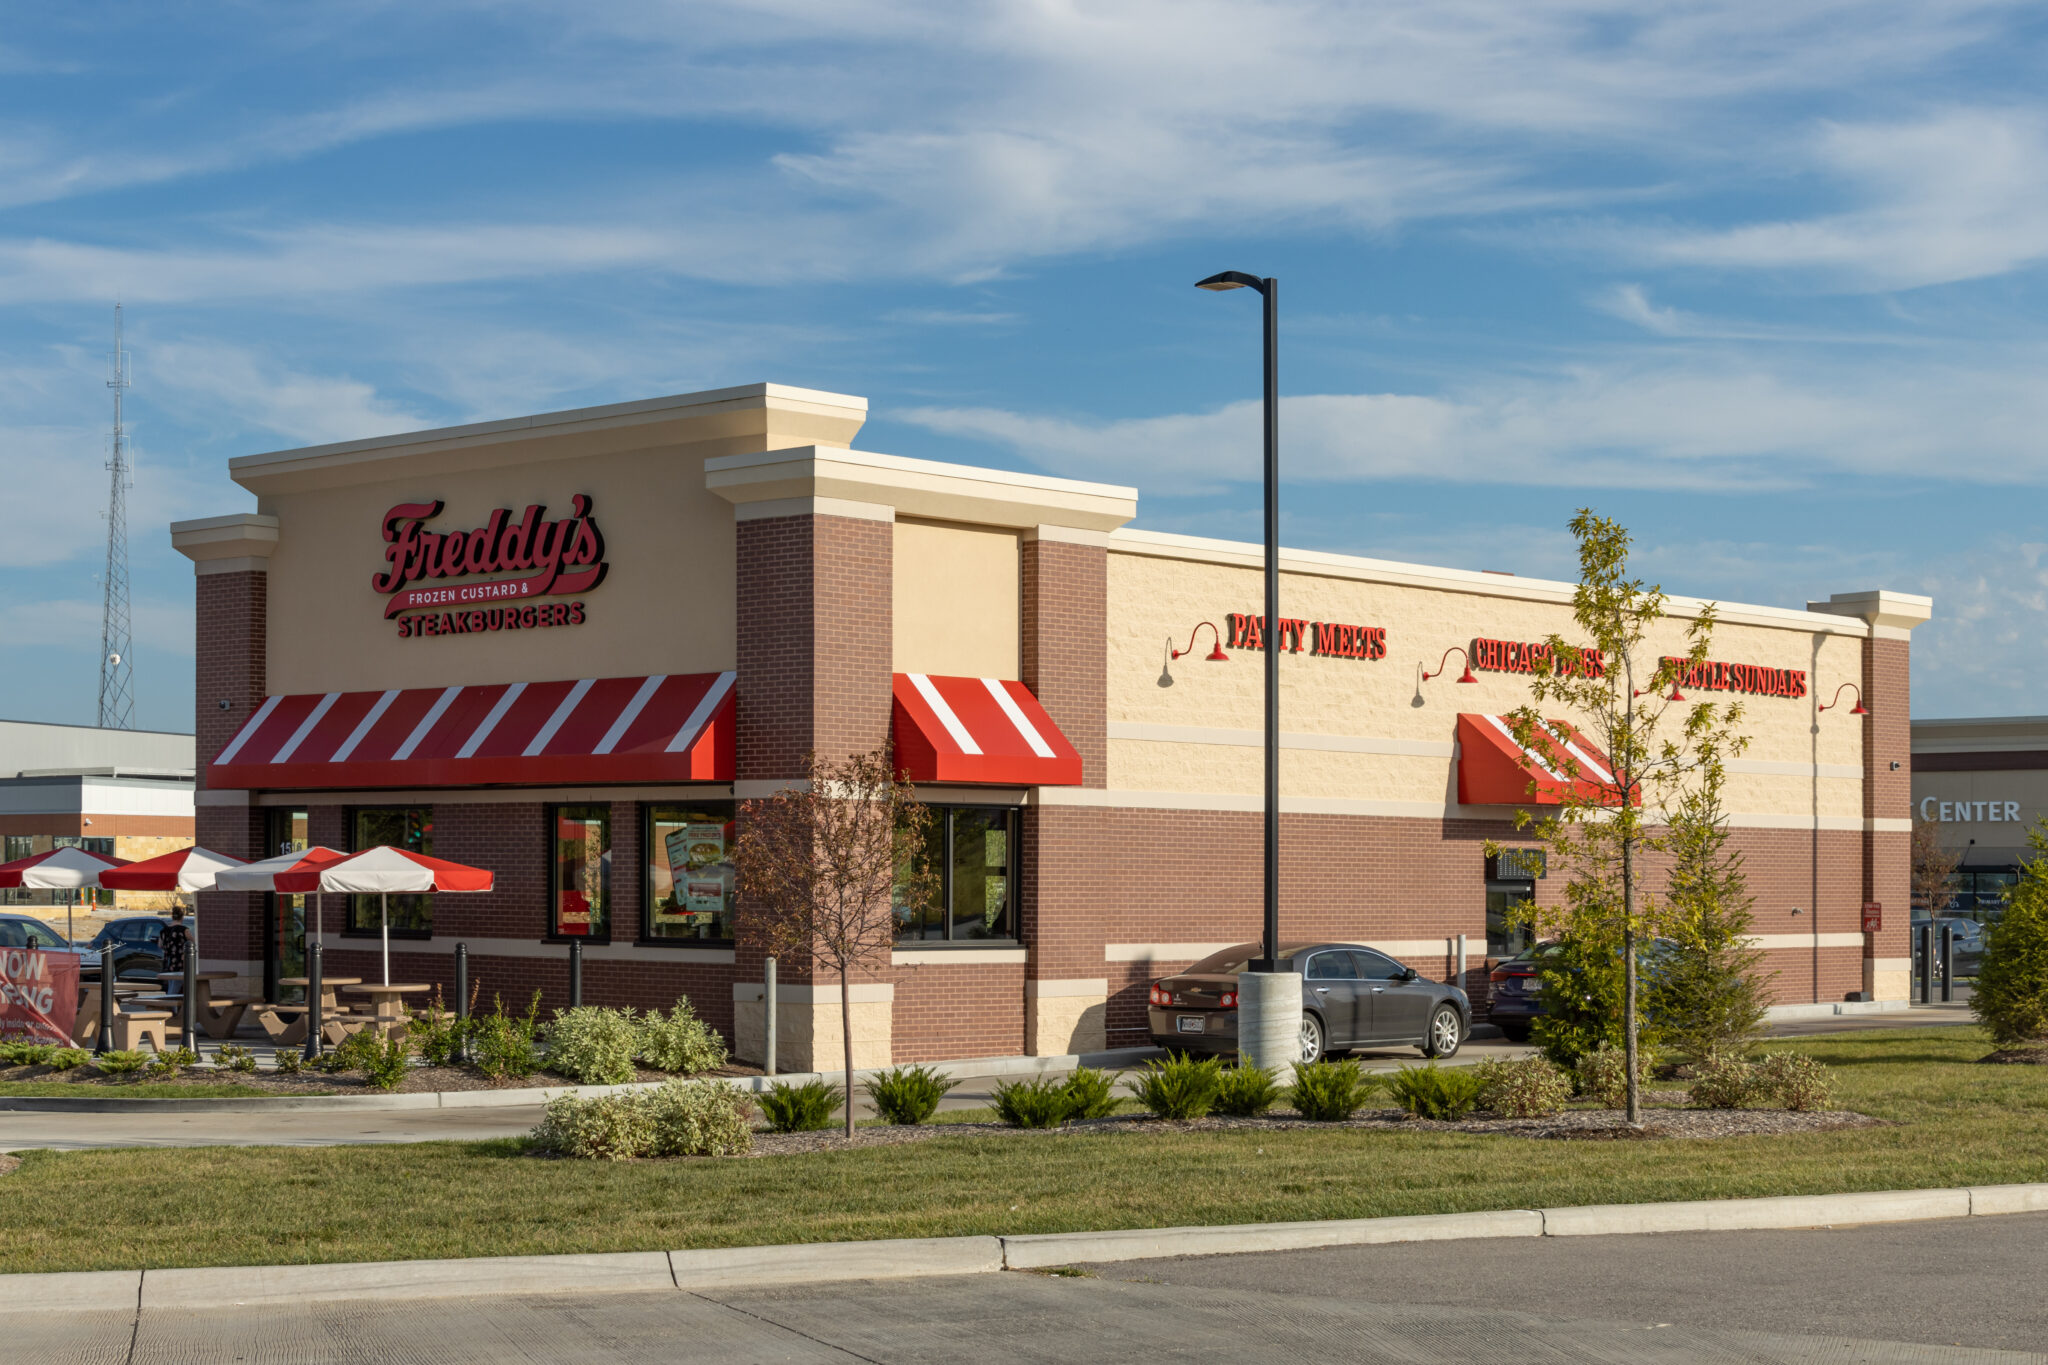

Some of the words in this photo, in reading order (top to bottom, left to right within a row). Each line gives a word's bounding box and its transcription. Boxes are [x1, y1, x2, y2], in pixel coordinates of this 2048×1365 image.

[372, 494, 608, 596] Freddy's
[409, 589, 456, 605] FROZEN
[460, 582, 517, 600] CUSTARD
[521, 582, 529, 594] &
[398, 602, 585, 638] STEAKBURGERS
[1230, 612, 1310, 653] PATY
[1314, 621, 1387, 660] MELTS
[1732, 662, 1807, 698] SUNDAES
[1920, 796, 2021, 822] CENTER
